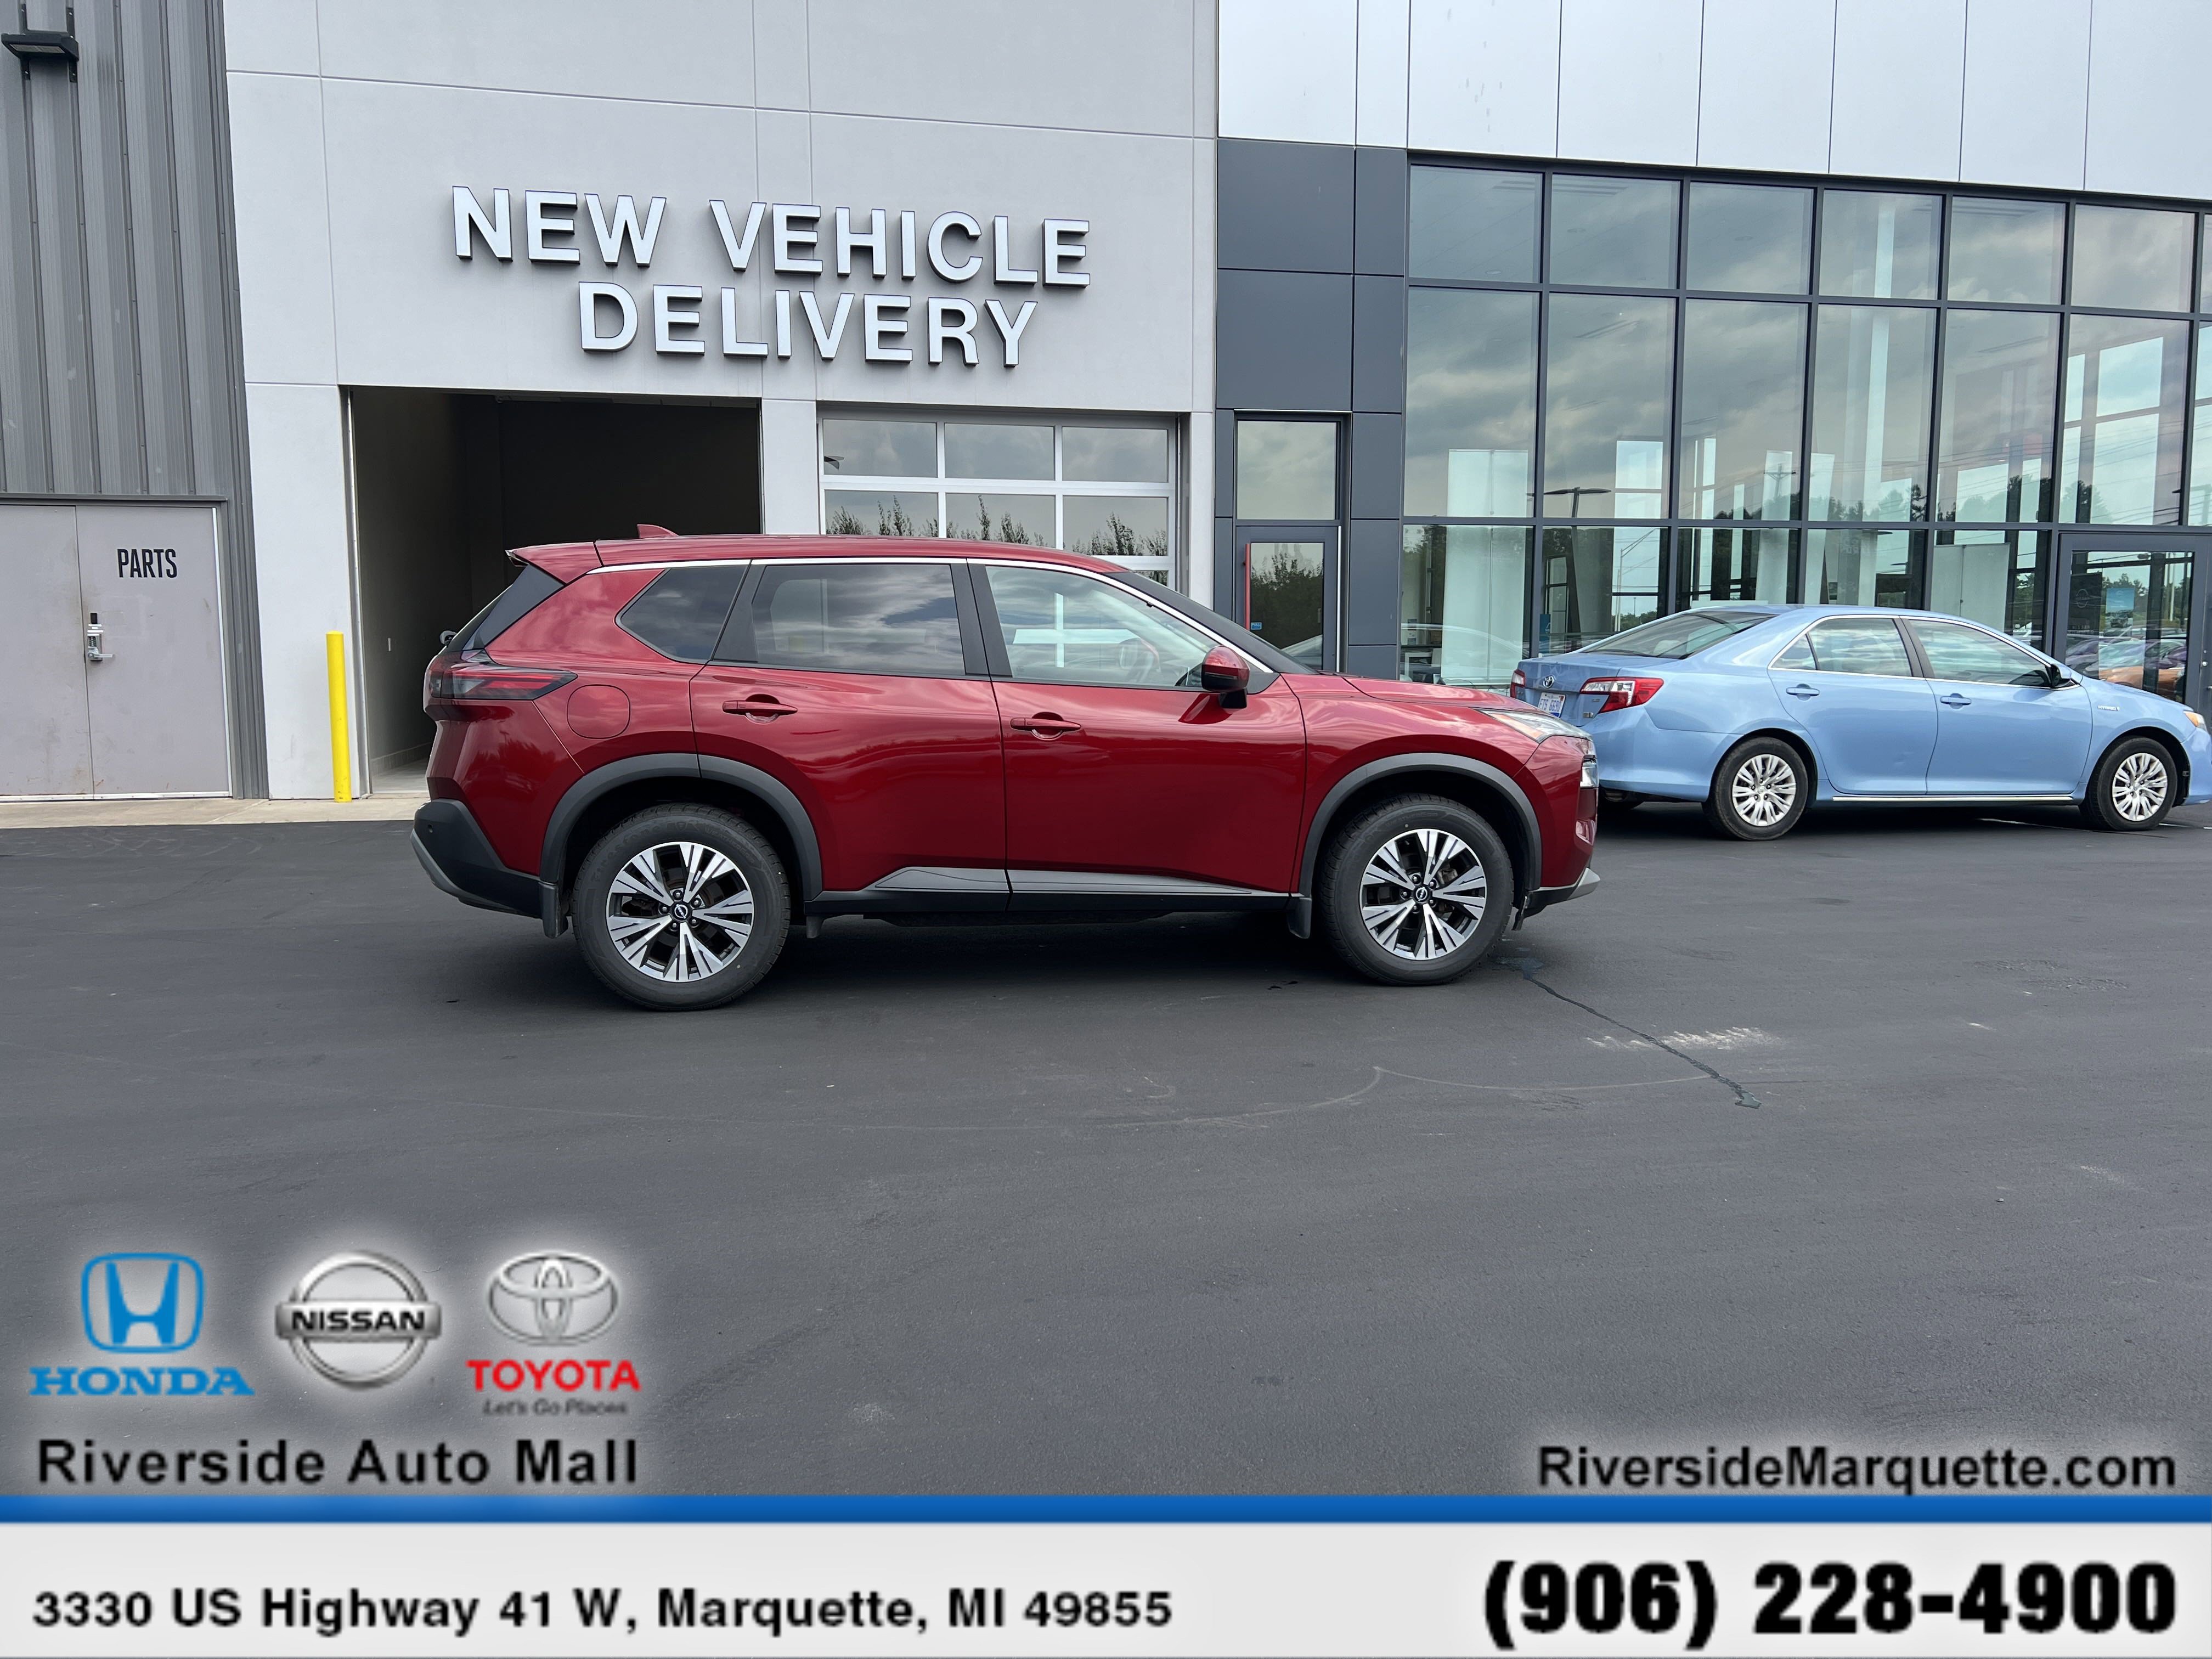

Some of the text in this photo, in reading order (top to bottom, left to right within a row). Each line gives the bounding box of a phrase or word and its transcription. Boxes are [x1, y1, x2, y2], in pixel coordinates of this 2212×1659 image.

[452, 185, 1091, 288] NEW VEHICLE
[578, 281, 1038, 369] DELIVERY
[117, 548, 178, 579] PARTS
